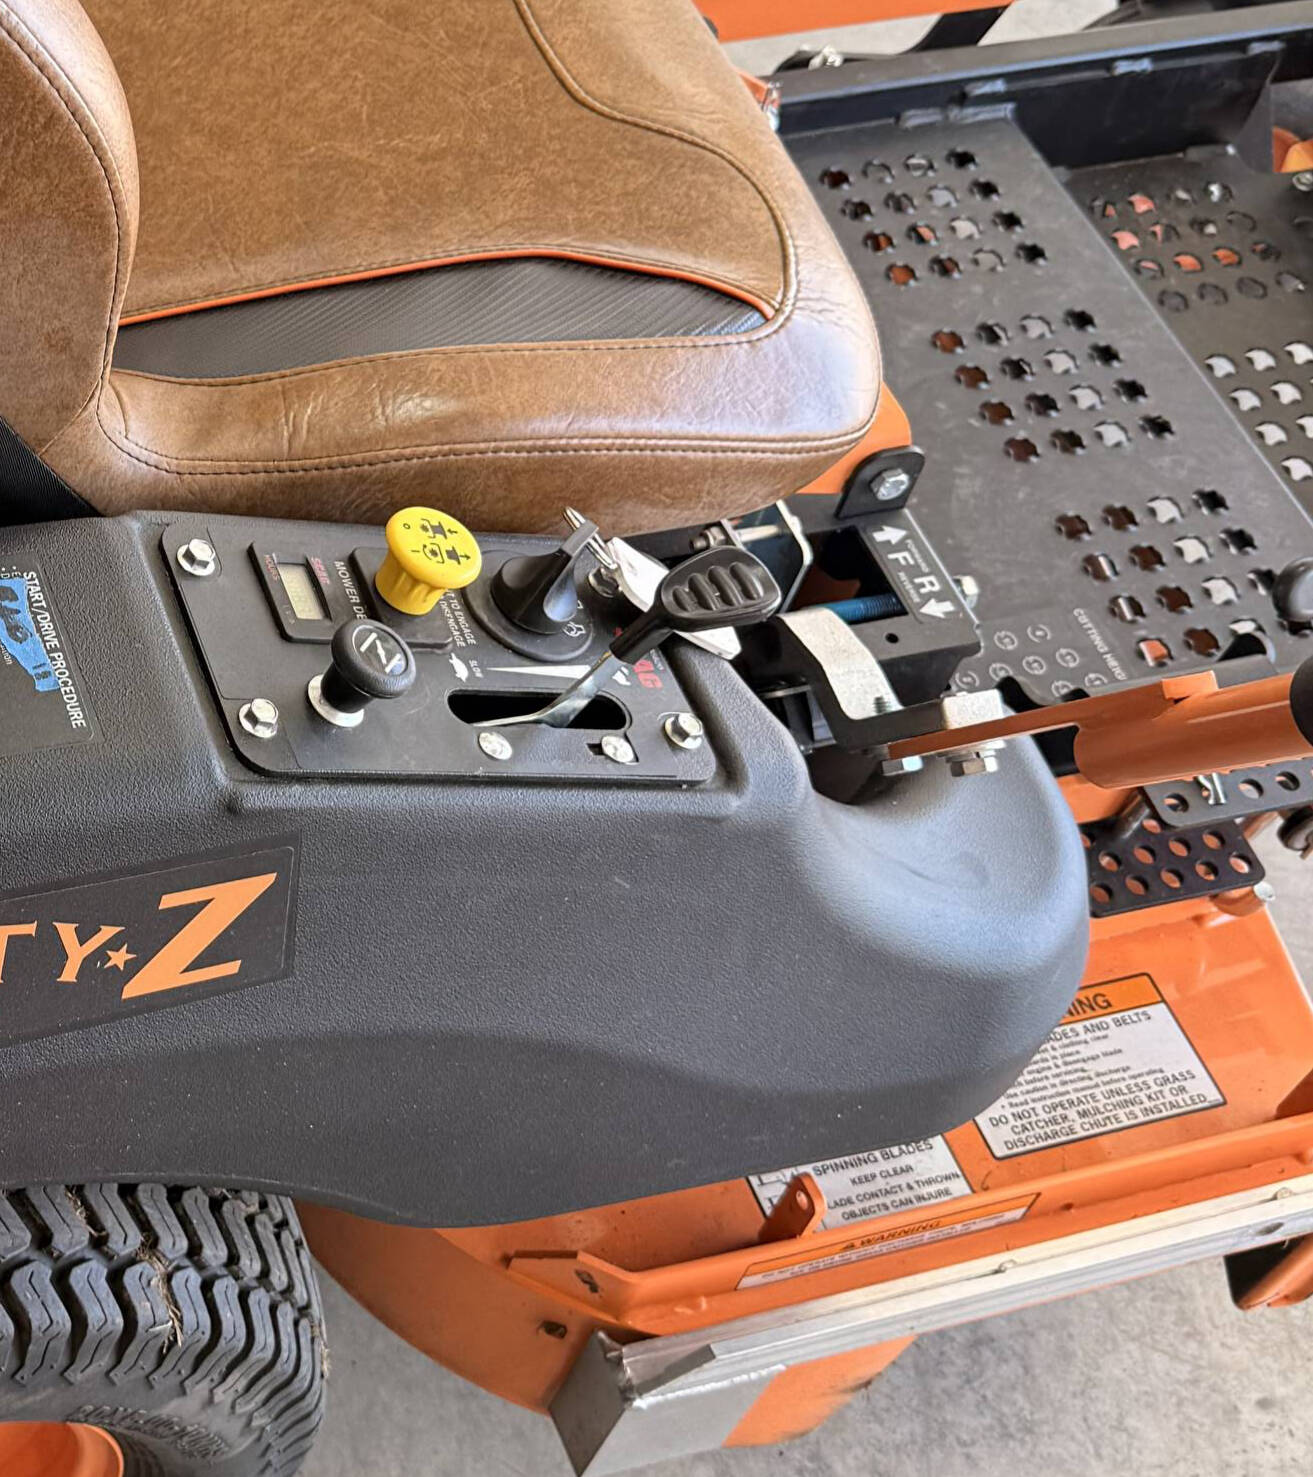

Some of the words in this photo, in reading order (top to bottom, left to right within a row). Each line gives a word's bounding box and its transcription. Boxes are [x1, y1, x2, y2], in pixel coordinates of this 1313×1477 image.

[888, 551, 915, 566] F
[333, 561, 360, 604] MOWER
[353, 605, 368, 621] DE
[913, 575, 940, 594] R
[454, 611, 476, 645] ENGAGE
[1073, 608, 1109, 653] CUTTING
[23, 571, 60, 650] START/DRIVE
[49, 652, 87, 730] PROCEDURE
[468, 660, 484, 678] SLOW
[122, 873, 277, 999] Z
[1045, 1027, 1080, 1043] ADES
[1083, 1017, 1109, 1036] AND
[1113, 1011, 1152, 1029] BELTS
[989, 1115, 1008, 1128] DO
[1014, 1107, 1039, 1122] NOT
[1043, 1094, 1096, 1115] OPERATE
[1101, 1080, 1152, 1101] UNLESS
[1154, 1070, 1196, 1088] GRASS
[1078, 1097, 1143, 1120] MULCHING
[1147, 1090, 1168, 1104] KIT
[1170, 1085, 1189, 1098] OR
[1004, 1126, 1077, 1151] DISCHARGE
[1081, 1115, 1123, 1132] CHUTE
[1126, 1109, 1139, 1120] IS
[1141, 1093, 1208, 1117] INSTALLED
[812, 1152, 878, 1176] SPINNING
[881, 1140, 934, 1160] BLADES
[850, 1171, 878, 1186] KEEP
[880, 1164, 914, 1179] CLEAR
[828, 1198, 854, 1210] LADE
[856, 1185, 904, 1204] CONTACT
[915, 1171, 961, 1190] THROWN
[841, 1203, 889, 1220] OBJECTS
[891, 1196, 914, 1208] CAN
[915, 1188, 952, 1204] INJURE
